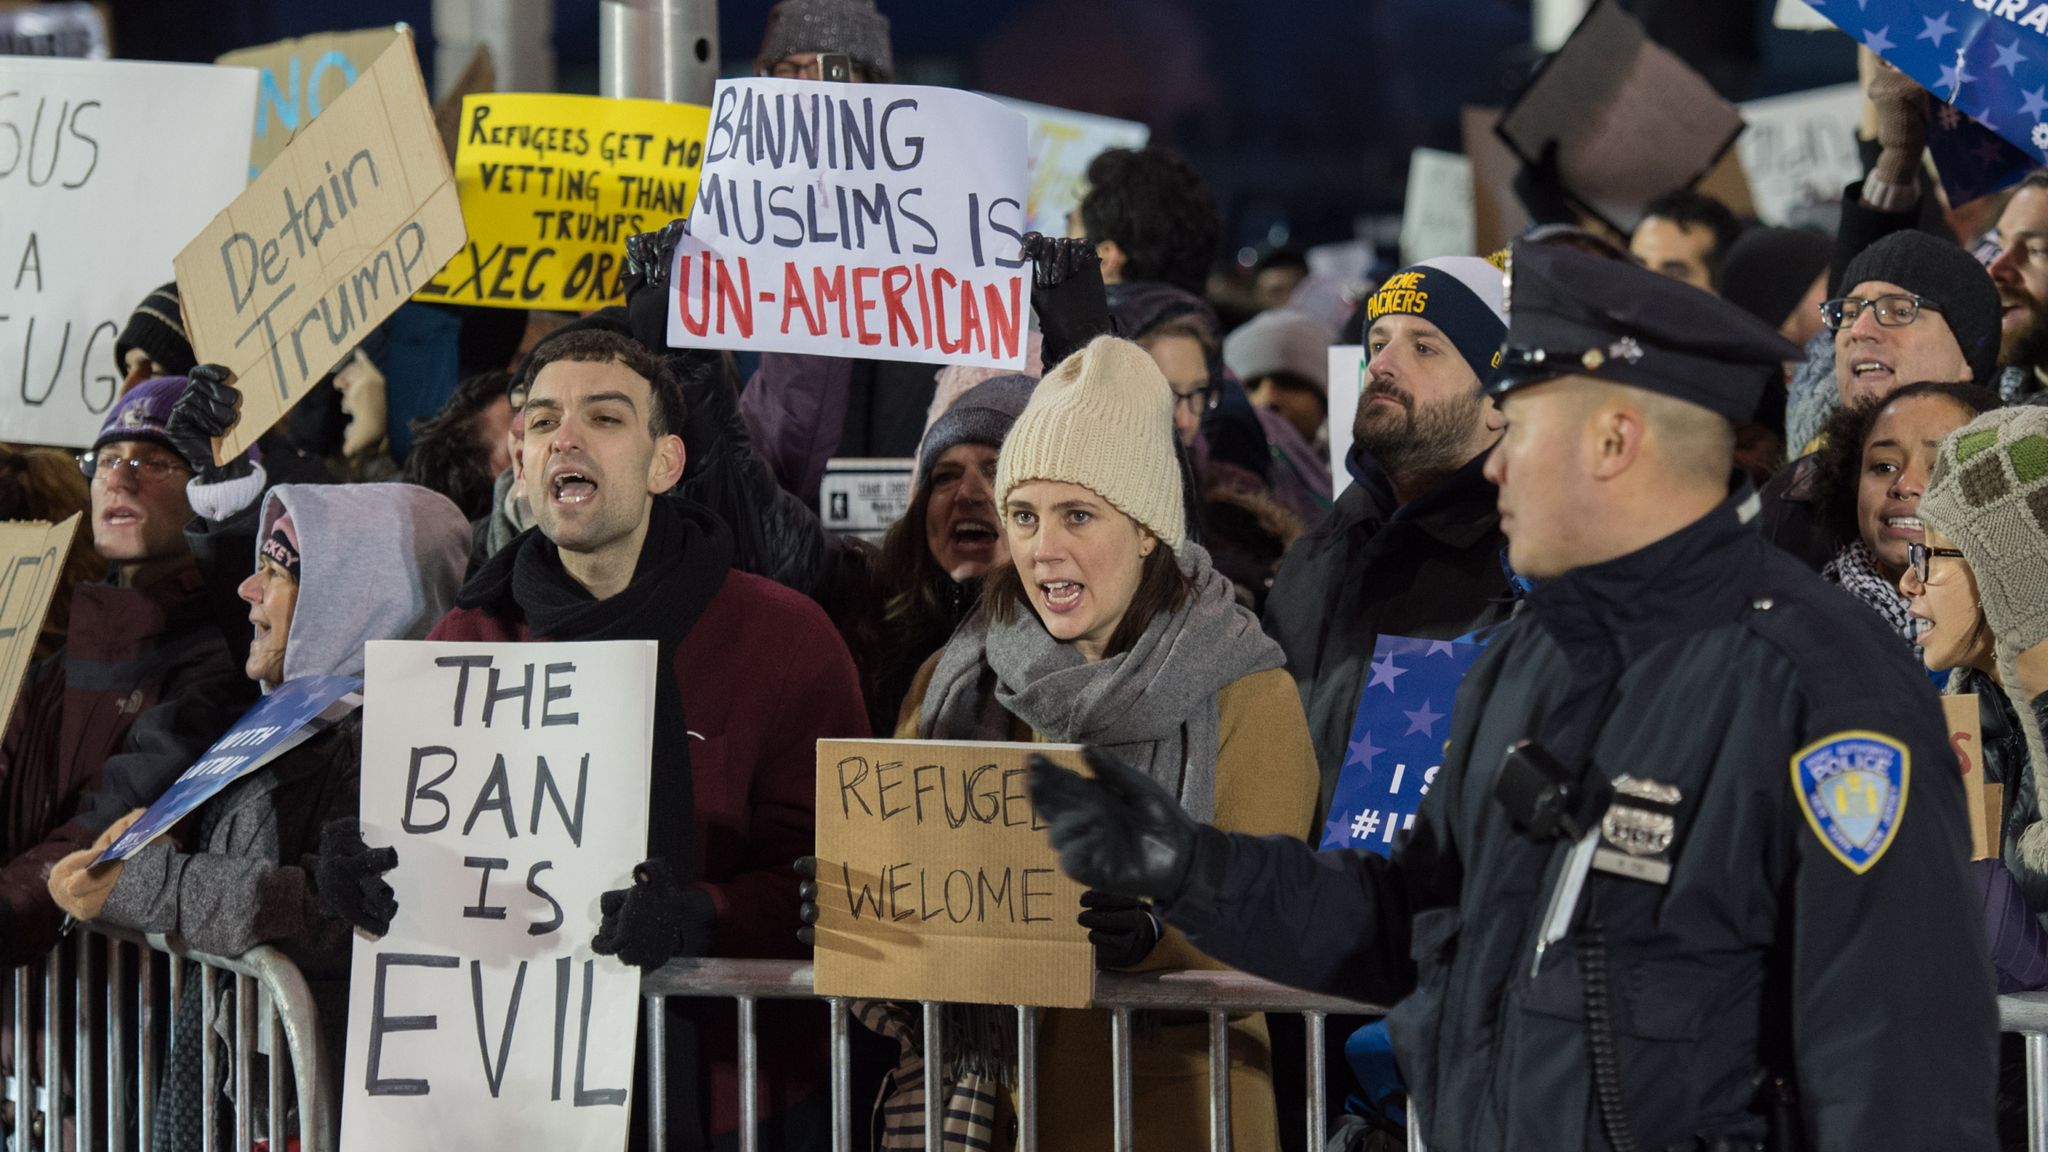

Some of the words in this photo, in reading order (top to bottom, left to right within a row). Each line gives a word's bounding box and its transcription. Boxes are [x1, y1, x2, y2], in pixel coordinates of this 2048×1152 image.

[469, 105, 589, 160] REFUGEES
[601, 131, 653, 166] GET
[706, 85, 925, 171] BANNING
[479, 163, 600, 212] VETTING
[619, 174, 687, 214] THAN
[684, 173, 938, 254] MUSLIMS
[968, 193, 1026, 268] IS
[14, 232, 42, 292] A
[220, 149, 380, 315] Detain
[679, 250, 1022, 359] UN-AMERICAN
[1367, 289, 1429, 321] PACKERS
[0, 317, 118, 416] UG
[434, 655, 579, 730] THE
[210, 725, 282, 753] WITH
[401, 745, 590, 848] BAN
[1389, 764, 1406, 794] I
[463, 855, 564, 936] IS
[842, 861, 1055, 924] WELOME
[365, 952, 627, 1107] EVIL
